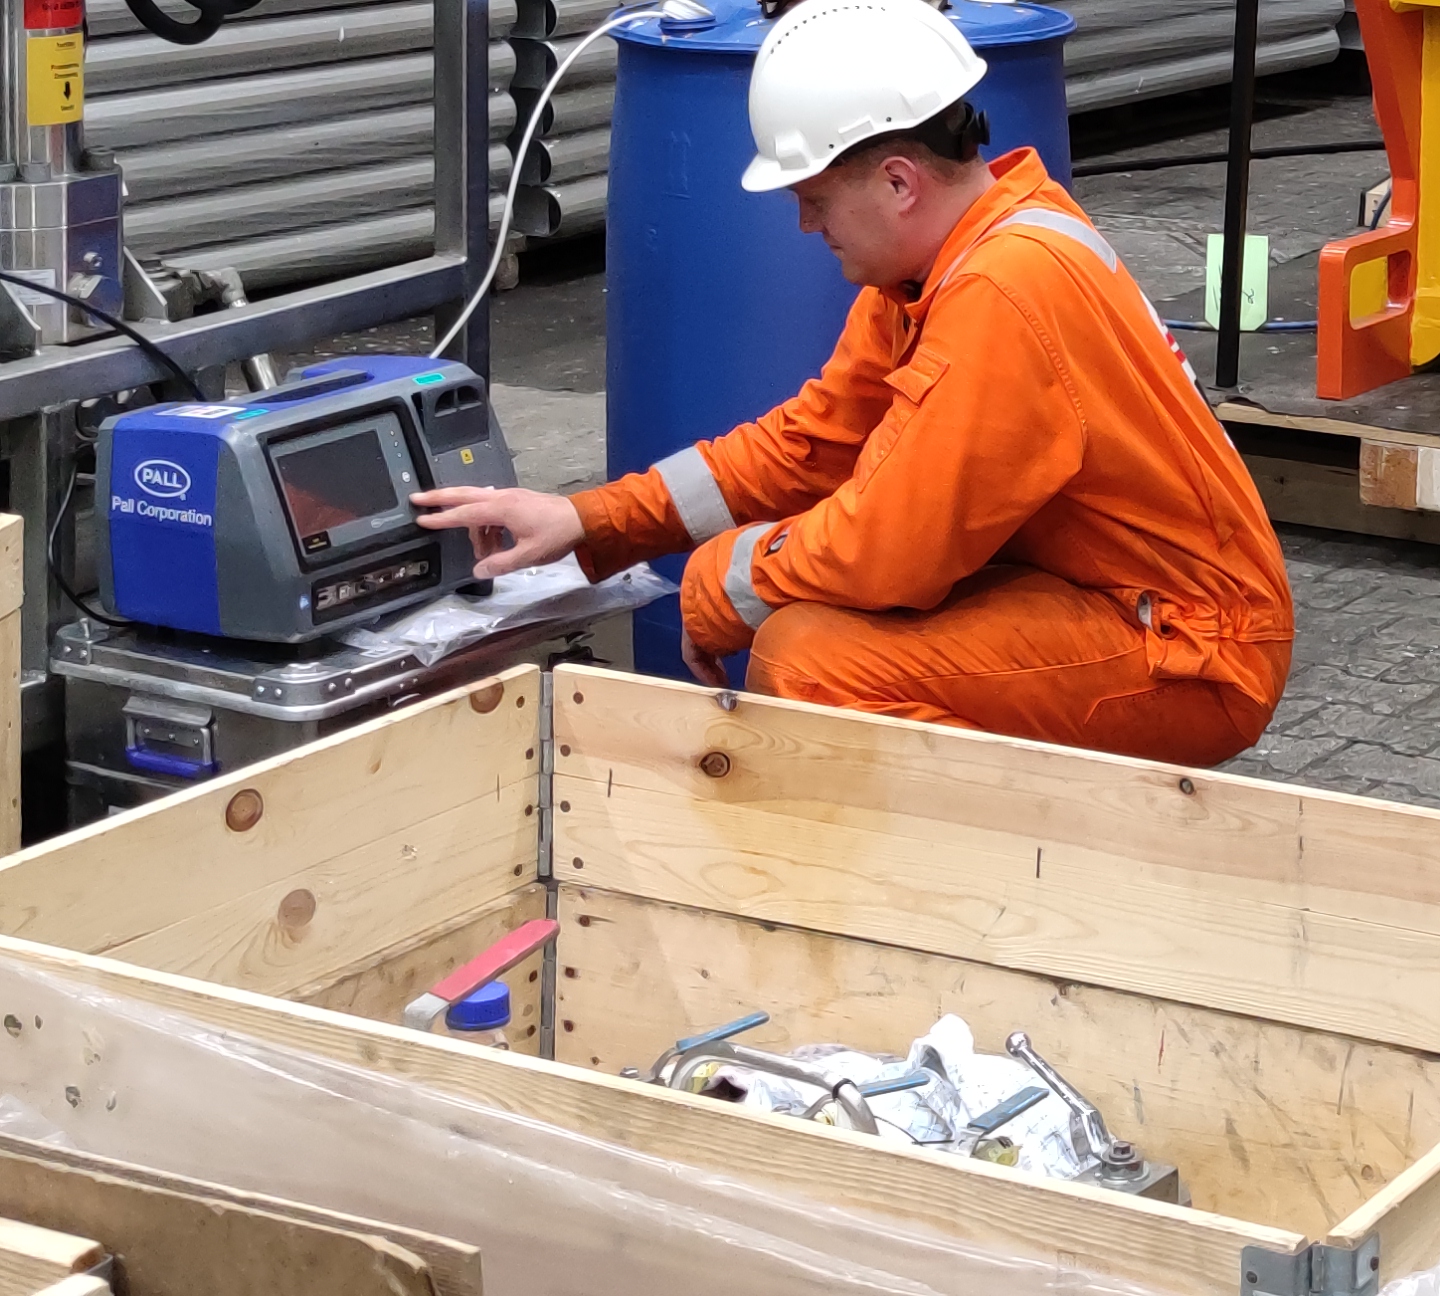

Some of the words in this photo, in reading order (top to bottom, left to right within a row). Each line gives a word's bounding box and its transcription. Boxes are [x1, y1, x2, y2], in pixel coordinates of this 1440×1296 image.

[142, 467, 182, 488] PALL
[111, 495, 134, 514] Pall
[137, 500, 212, 527] Corporation
